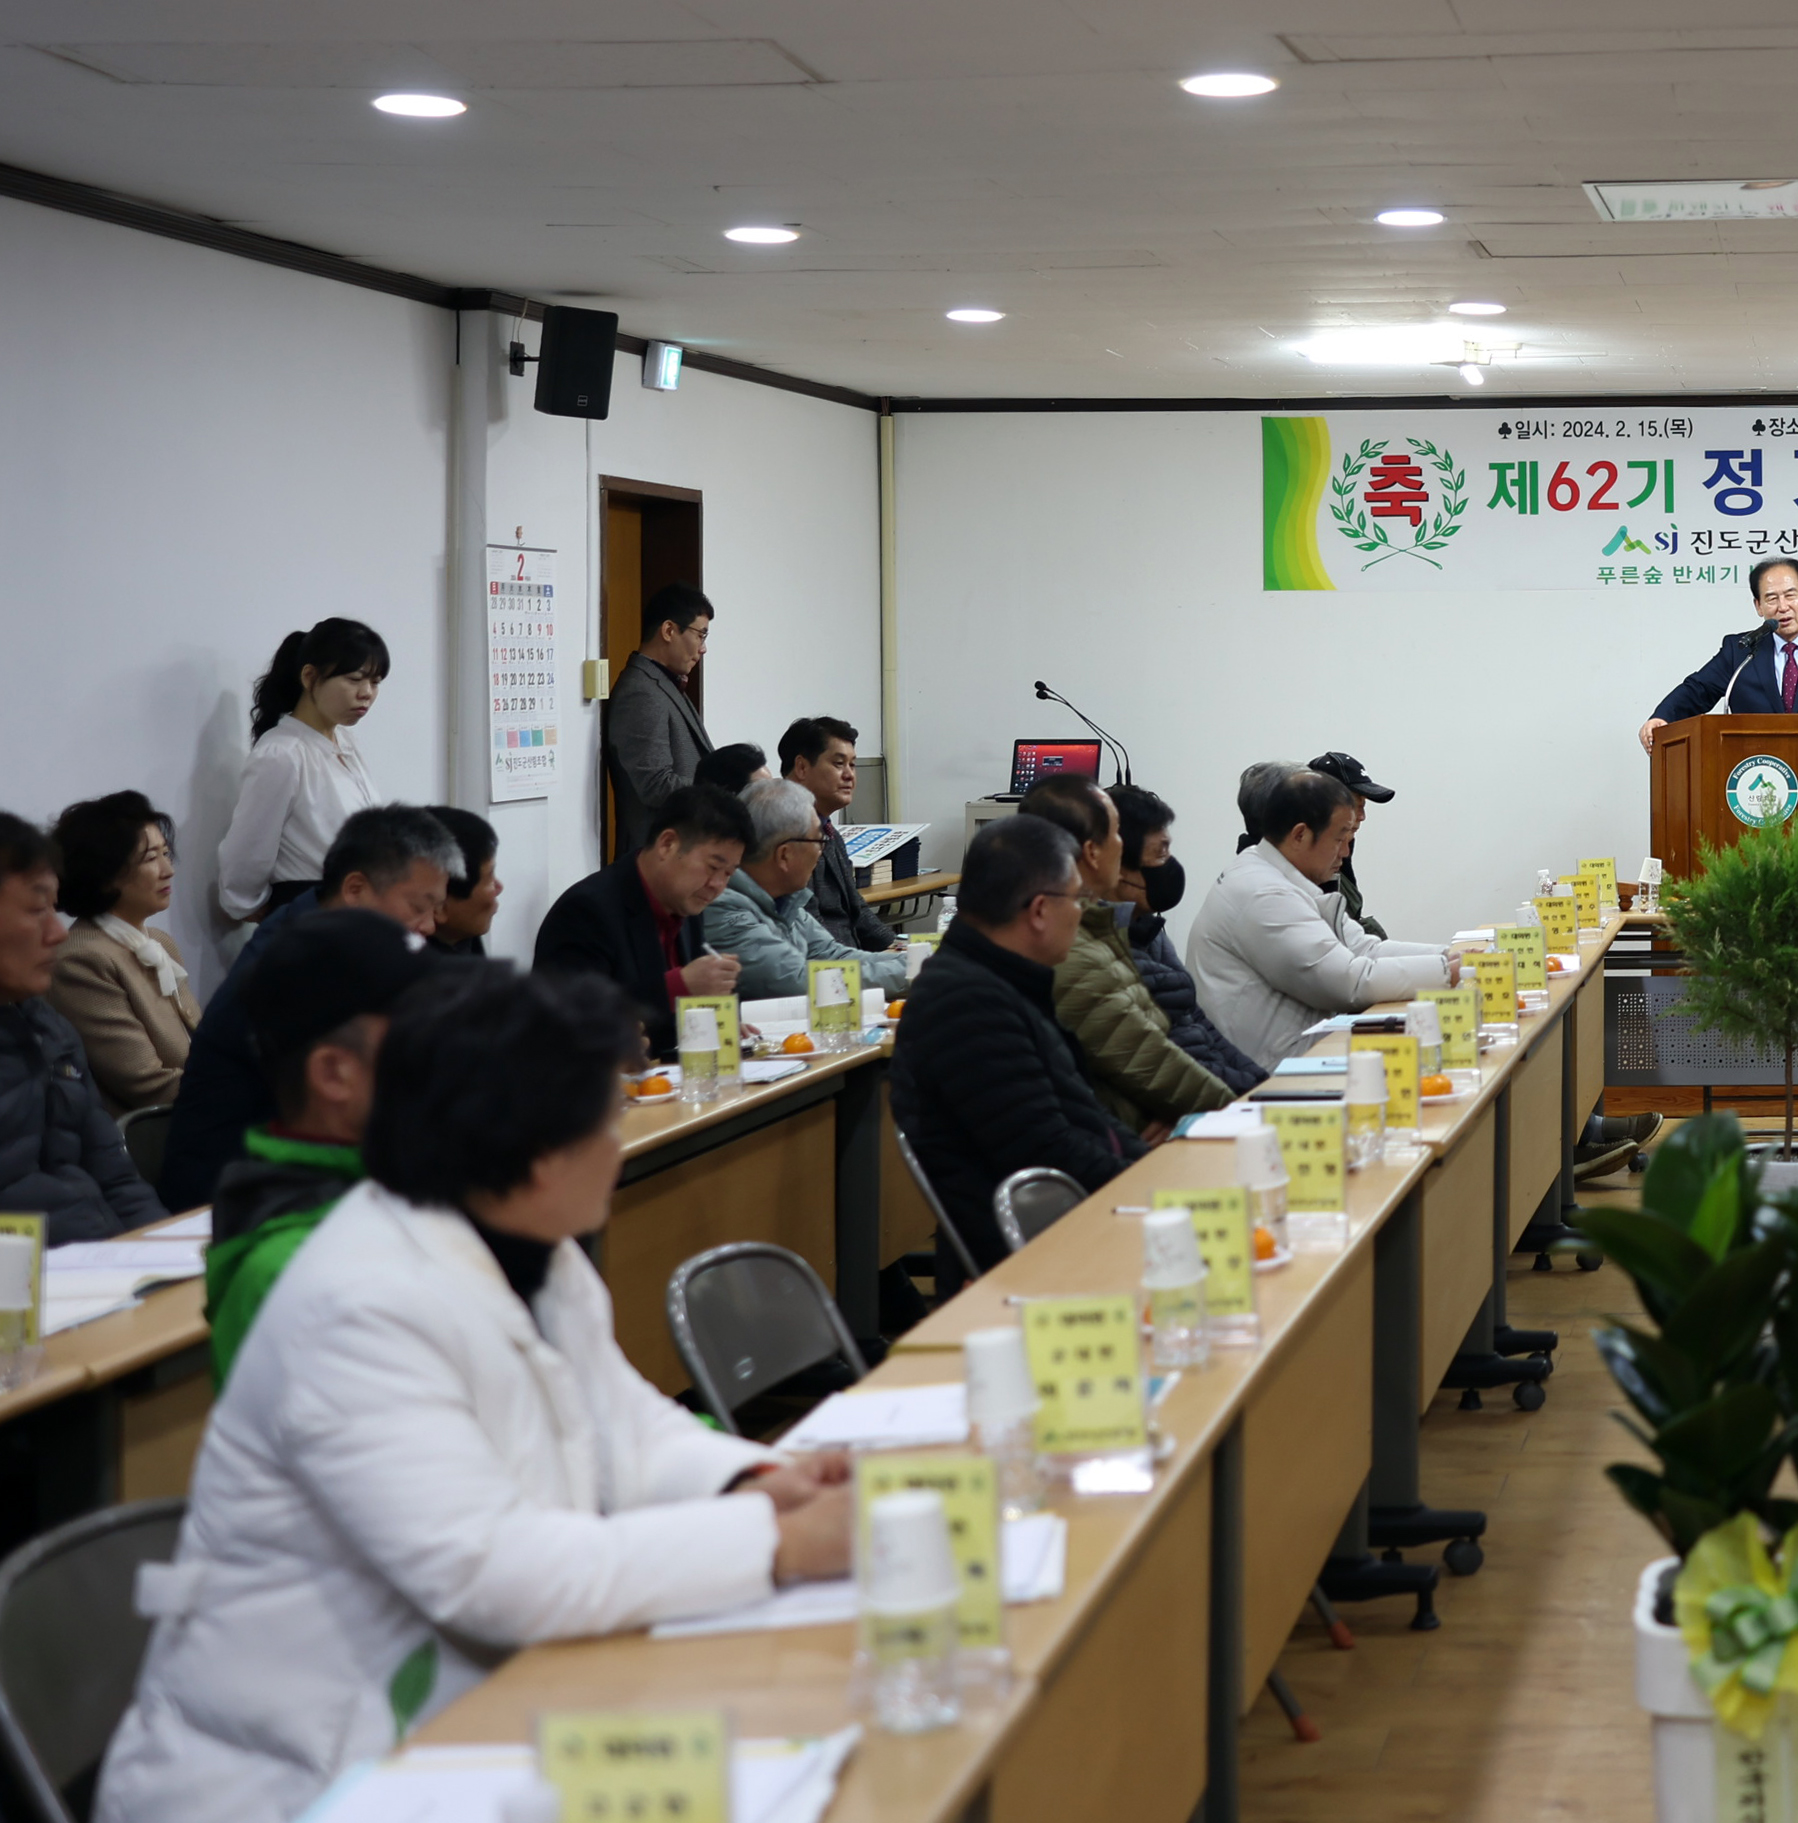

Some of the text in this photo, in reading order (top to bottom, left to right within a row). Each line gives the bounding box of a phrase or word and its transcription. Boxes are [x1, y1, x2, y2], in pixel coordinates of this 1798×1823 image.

[1515, 418, 1693, 439] 일시: 2024. 2. 15.(목)
[1364, 454, 1429, 527] 축
[1486, 459, 1675, 515] 제62기
[517, 553, 525, 581] 2
[1596, 564, 1664, 585] 푸른숲
[1673, 564, 1739, 584] 반세기
[528, 598, 532, 611] 1
[537, 598, 541, 611] 2
[547, 599, 551, 612] 3
[501, 622, 505, 635] 5
[510, 622, 514, 635] 6
[519, 622, 523, 636] 7
[528, 623, 532, 636] 8
[537, 623, 542, 636] 9
[493, 647, 554, 661] 11 12 13 14 15 16 17
[501, 672, 508, 686] 19
[510, 672, 517, 686] 20
[519, 672, 526, 686] 21
[528, 672, 535, 685] 22
[537, 672, 545, 685] 23
[494, 698, 501, 712] 25
[502, 698, 509, 711] 26
[511, 697, 518, 711] 27
[520, 697, 527, 710] 28
[528, 697, 536, 710] 29
[1732, 757, 1791, 780] Forestry Cooperative
